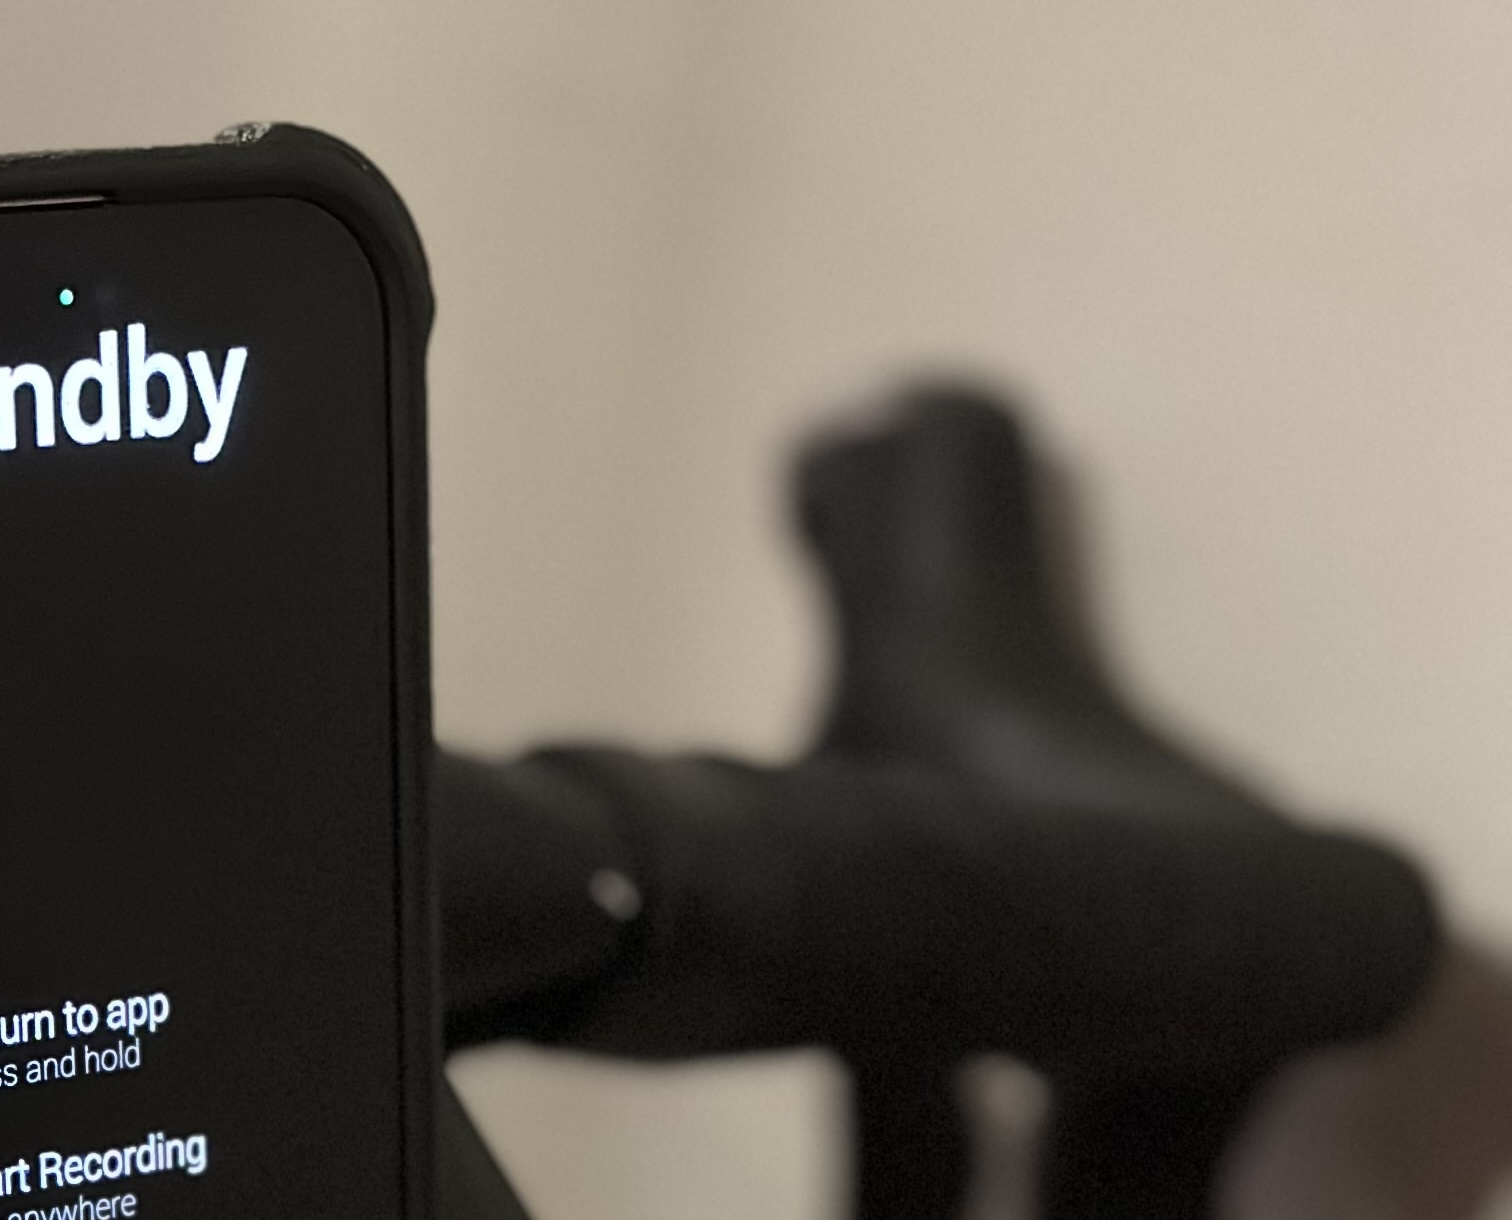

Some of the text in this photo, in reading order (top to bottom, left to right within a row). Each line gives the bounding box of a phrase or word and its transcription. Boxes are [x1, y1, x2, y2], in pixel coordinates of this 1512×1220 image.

[62, 1000, 98, 1036] to
[106, 992, 170, 1035] app
[26, 1048, 76, 1083] and
[84, 1037, 141, 1074] hold
[39, 1132, 208, 1189] Recording
